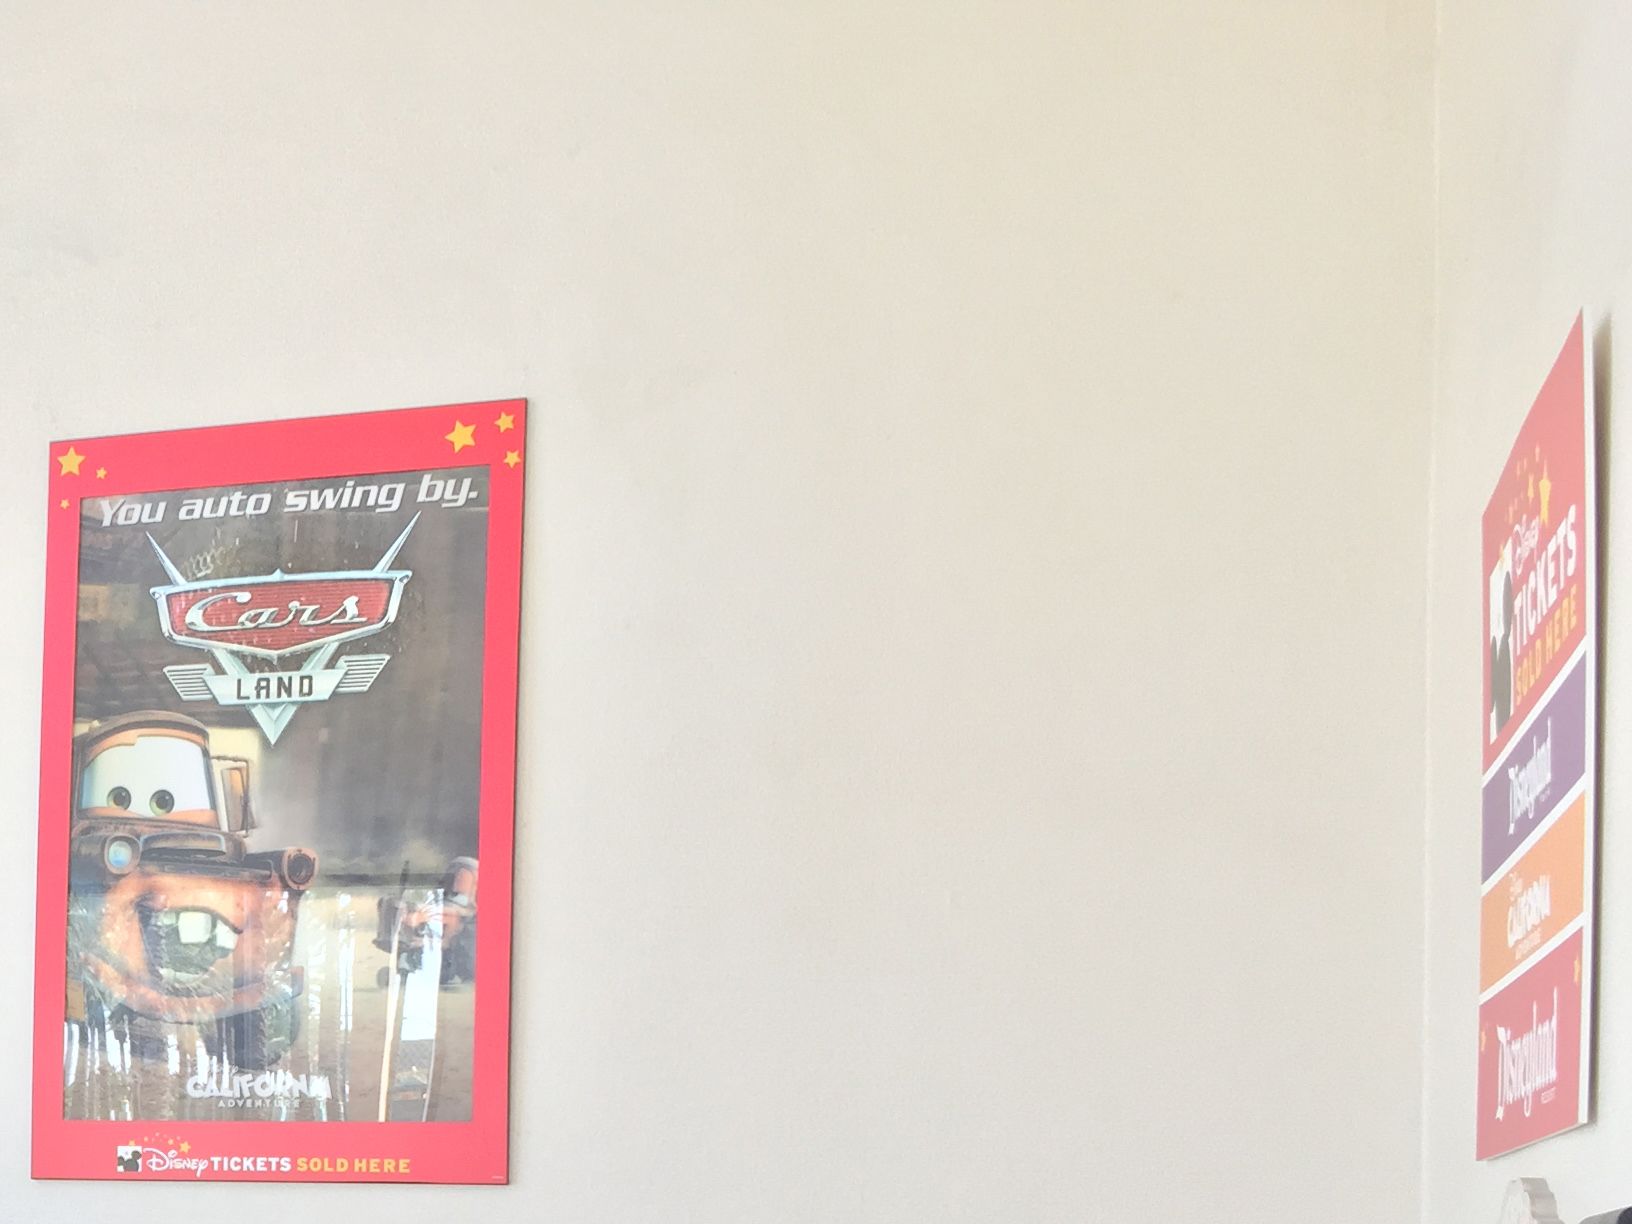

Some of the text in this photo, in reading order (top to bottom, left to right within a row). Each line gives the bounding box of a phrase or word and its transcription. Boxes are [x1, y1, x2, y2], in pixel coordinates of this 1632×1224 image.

[99, 474, 479, 528] You auto swing by.
[1514, 504, 1577, 656] TICKETS
[185, 591, 368, 632] Cars
[1516, 584, 1577, 706] SOLD HERE
[236, 675, 313, 700] LAND
[143, 1147, 411, 1177] Disney TICKETS SOLD HERE
